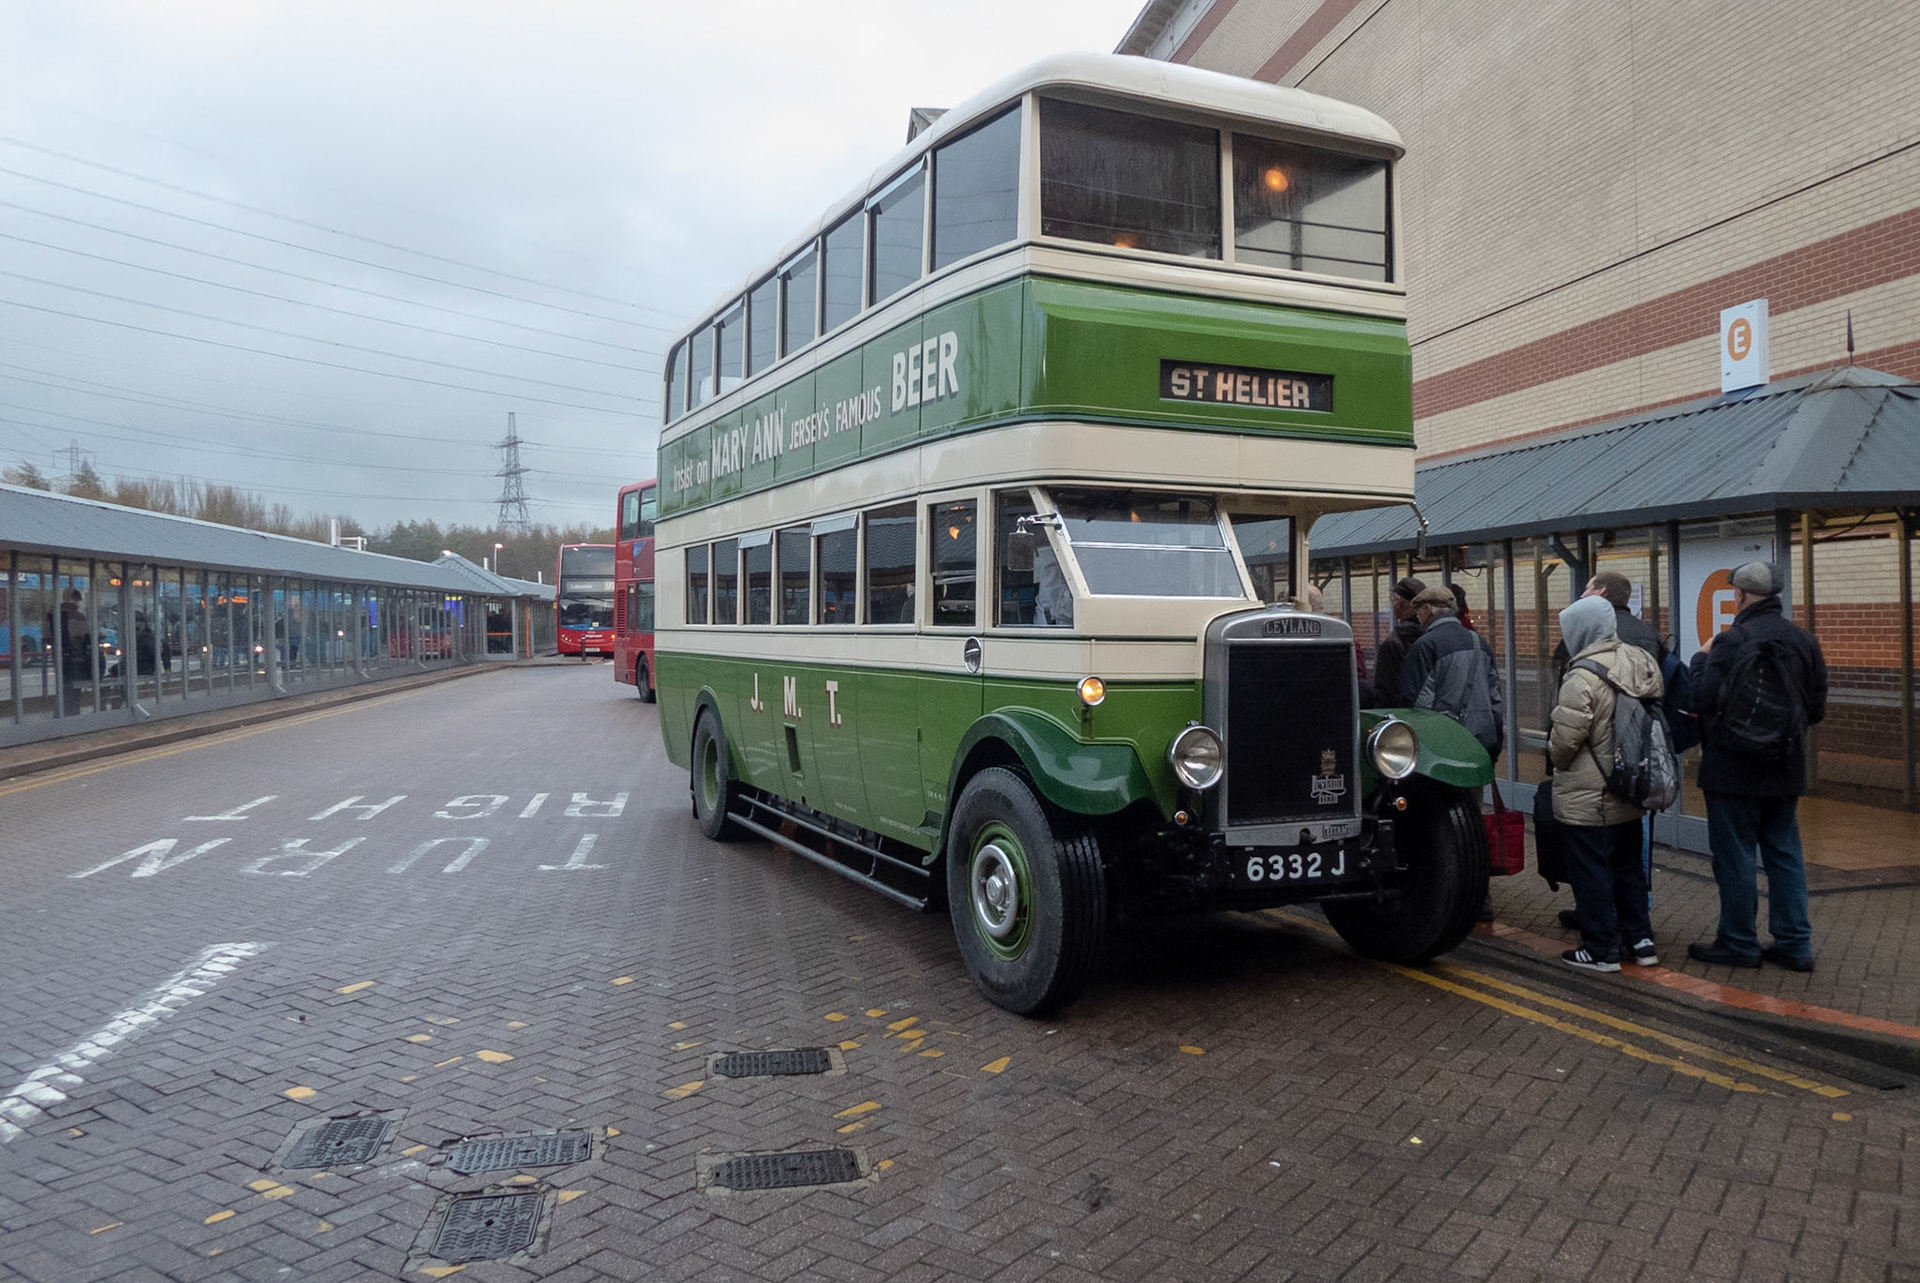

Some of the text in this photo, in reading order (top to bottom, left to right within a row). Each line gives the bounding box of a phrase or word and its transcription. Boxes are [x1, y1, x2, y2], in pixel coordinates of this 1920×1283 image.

[1734, 325, 1747, 354] E
[1216, 371, 1310, 409] HELIER
[673, 459, 693, 493] Insist
[696, 459, 708, 485] on
[789, 402, 830, 450] JERSEY'S
[835, 385, 881, 434] FAMOUS
[891, 331, 960, 415] BEER
[1266, 618, 1321, 635] LEYLAND
[182, 791, 631, 821] RIGHT
[1246, 849, 1345, 882] 6332 J
